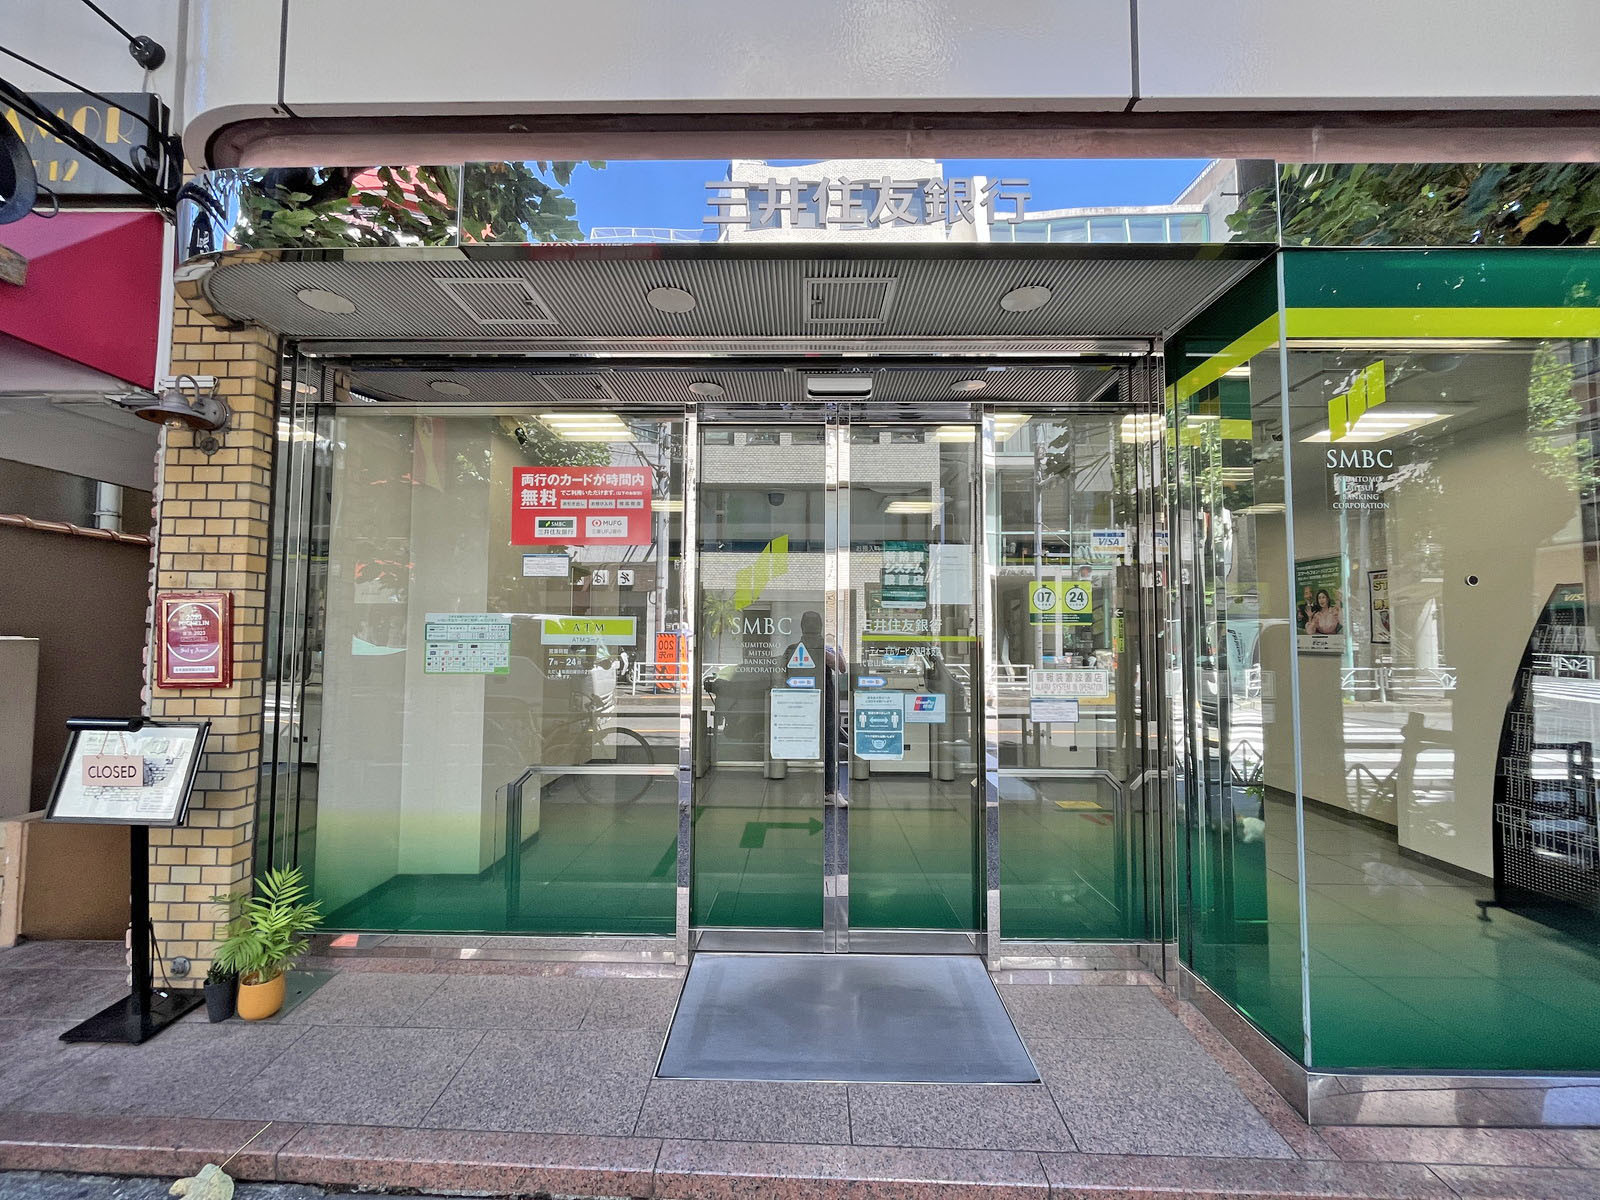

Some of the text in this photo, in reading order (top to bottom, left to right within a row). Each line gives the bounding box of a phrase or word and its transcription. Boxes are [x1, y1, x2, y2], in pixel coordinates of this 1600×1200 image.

[702, 176, 1031, 225] 三井住友銀行
[1326, 449, 1394, 469] SMBC
[521, 473, 645, 487] 両行のカードが時間内
[520, 488, 557, 506] 無料
[1098, 538, 1120, 546] VISA
[1036, 591, 1085, 602] 07 24
[572, 623, 605, 632] ATM
[731, 617, 792, 635] SMBC
[863, 619, 943, 632] 三井住友銀行
[87, 765, 137, 779] CLOSED
